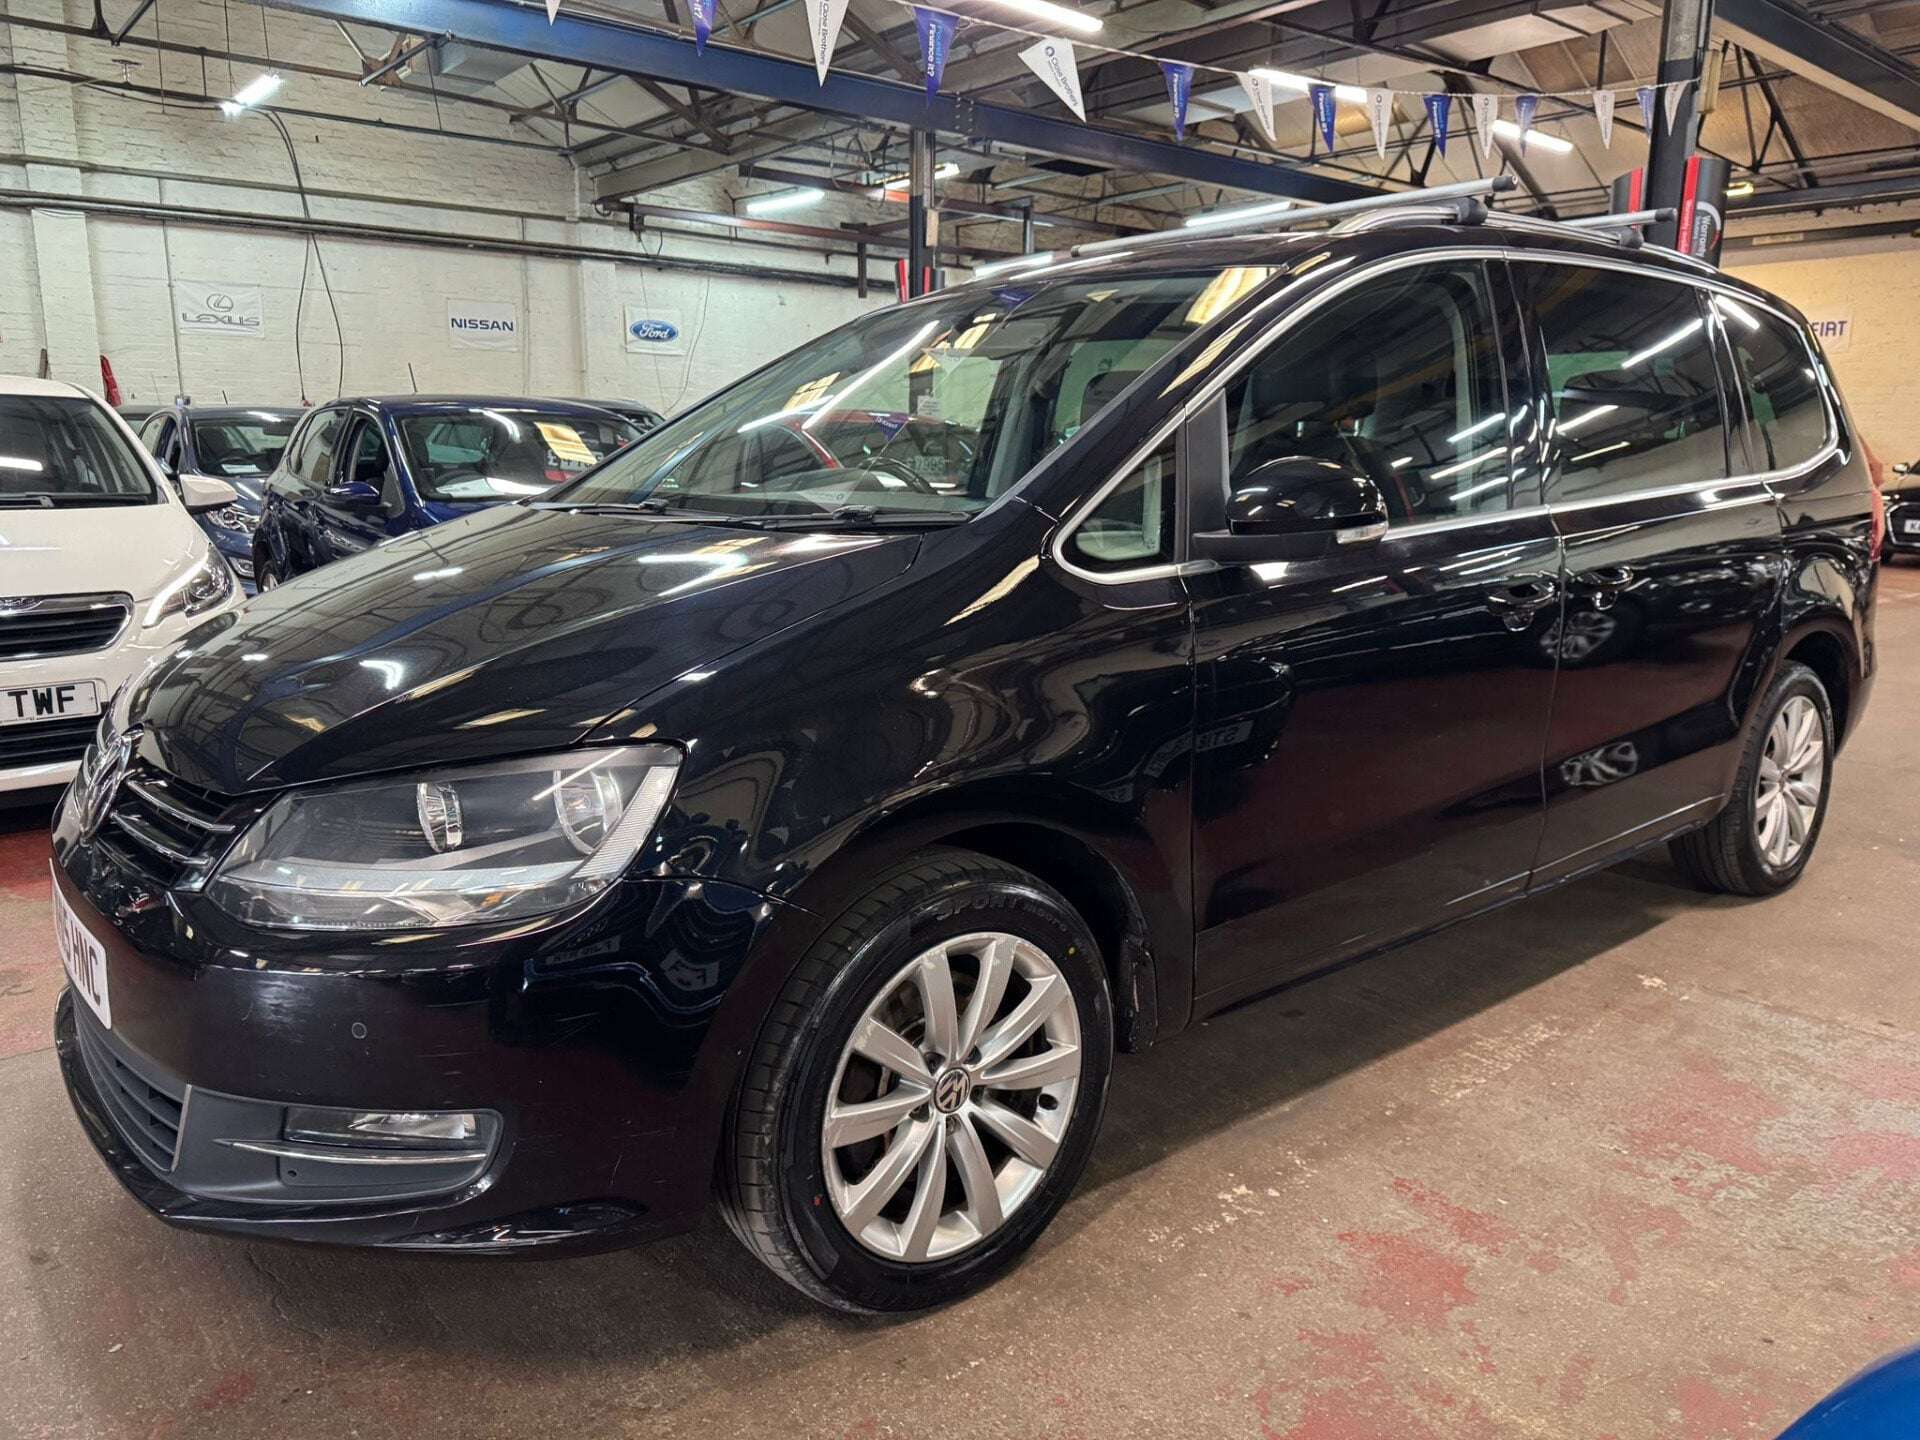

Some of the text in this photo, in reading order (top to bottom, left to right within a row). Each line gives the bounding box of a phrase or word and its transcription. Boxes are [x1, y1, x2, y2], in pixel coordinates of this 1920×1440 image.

[927, 23, 937, 77] Finance it?
[182, 312, 260, 327] LEXUS
[450, 317, 514, 332] NISSAN
[1811, 319, 1848, 337] FIAT
[639, 321, 671, 338] Ford
[7, 685, 76, 718] TWF
[70, 920, 102, 1007] HNC
